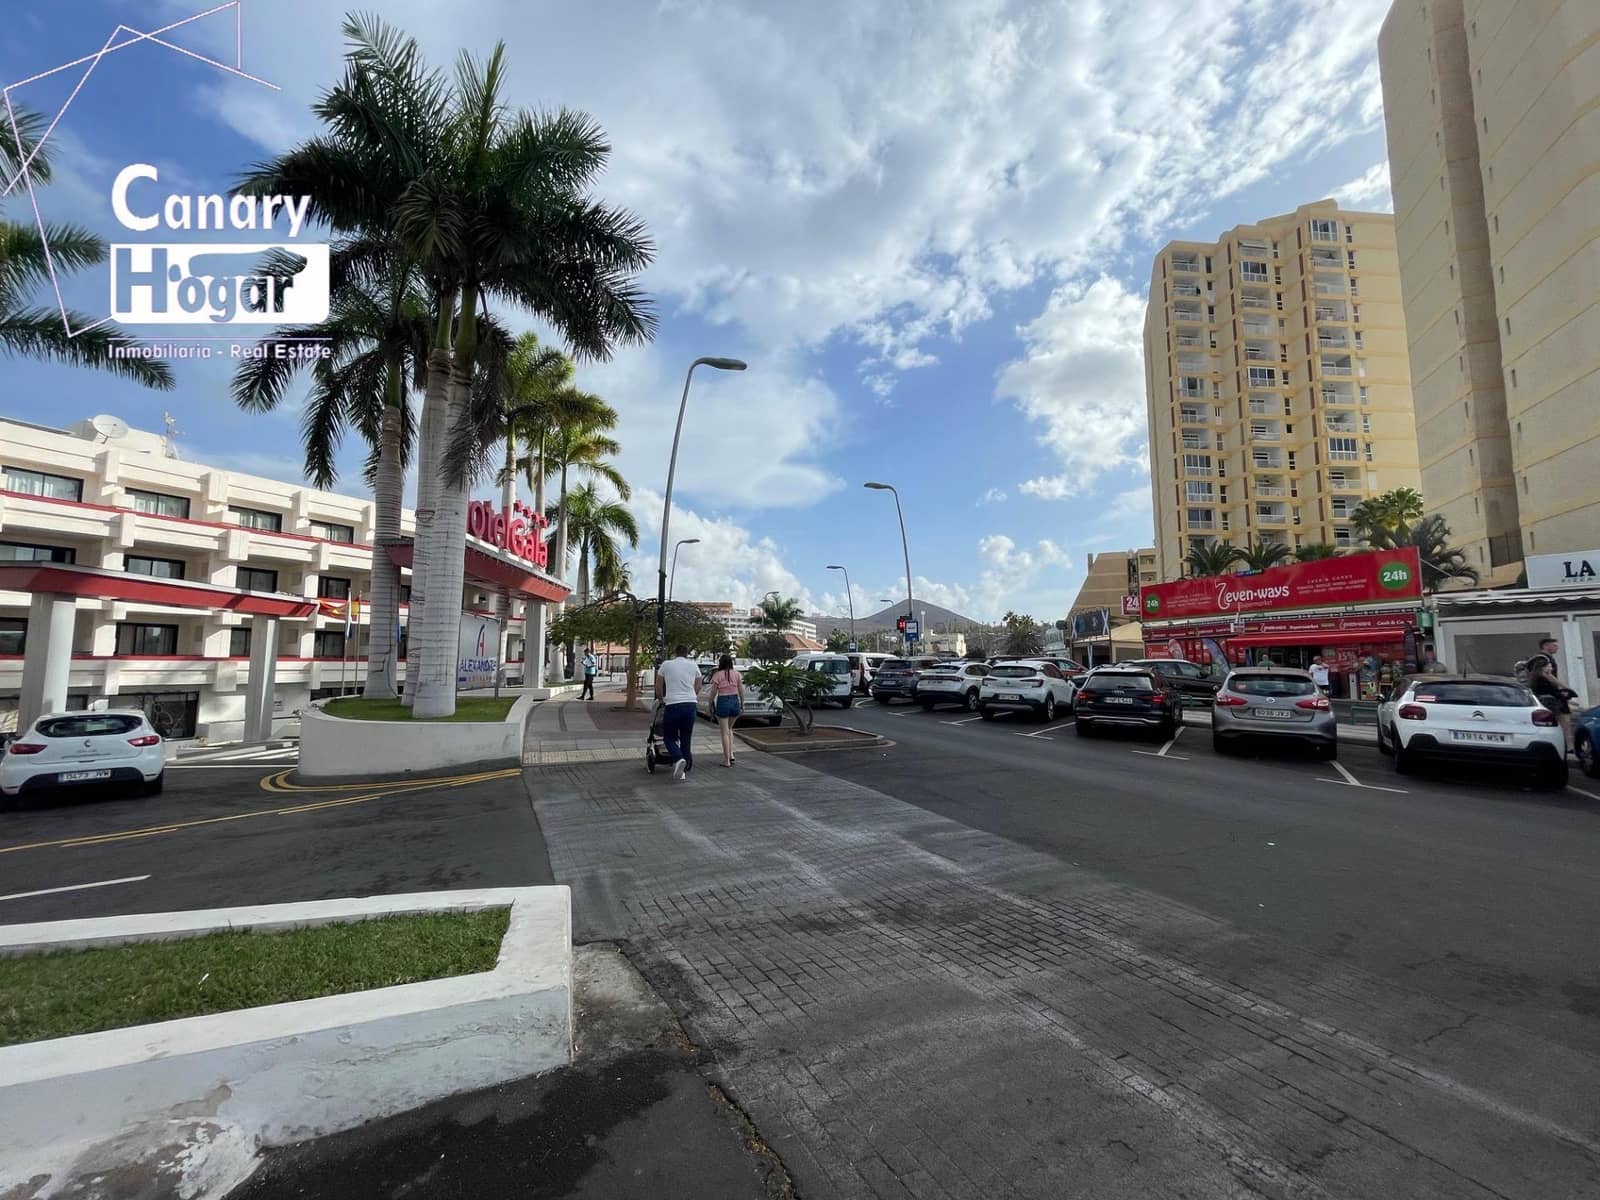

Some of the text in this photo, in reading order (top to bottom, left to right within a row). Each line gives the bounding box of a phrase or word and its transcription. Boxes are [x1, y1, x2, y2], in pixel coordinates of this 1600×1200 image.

[468, 499, 511, 552] otel
[1382, 569, 1408, 582] 24h
[1562, 559, 1597, 578] LA
